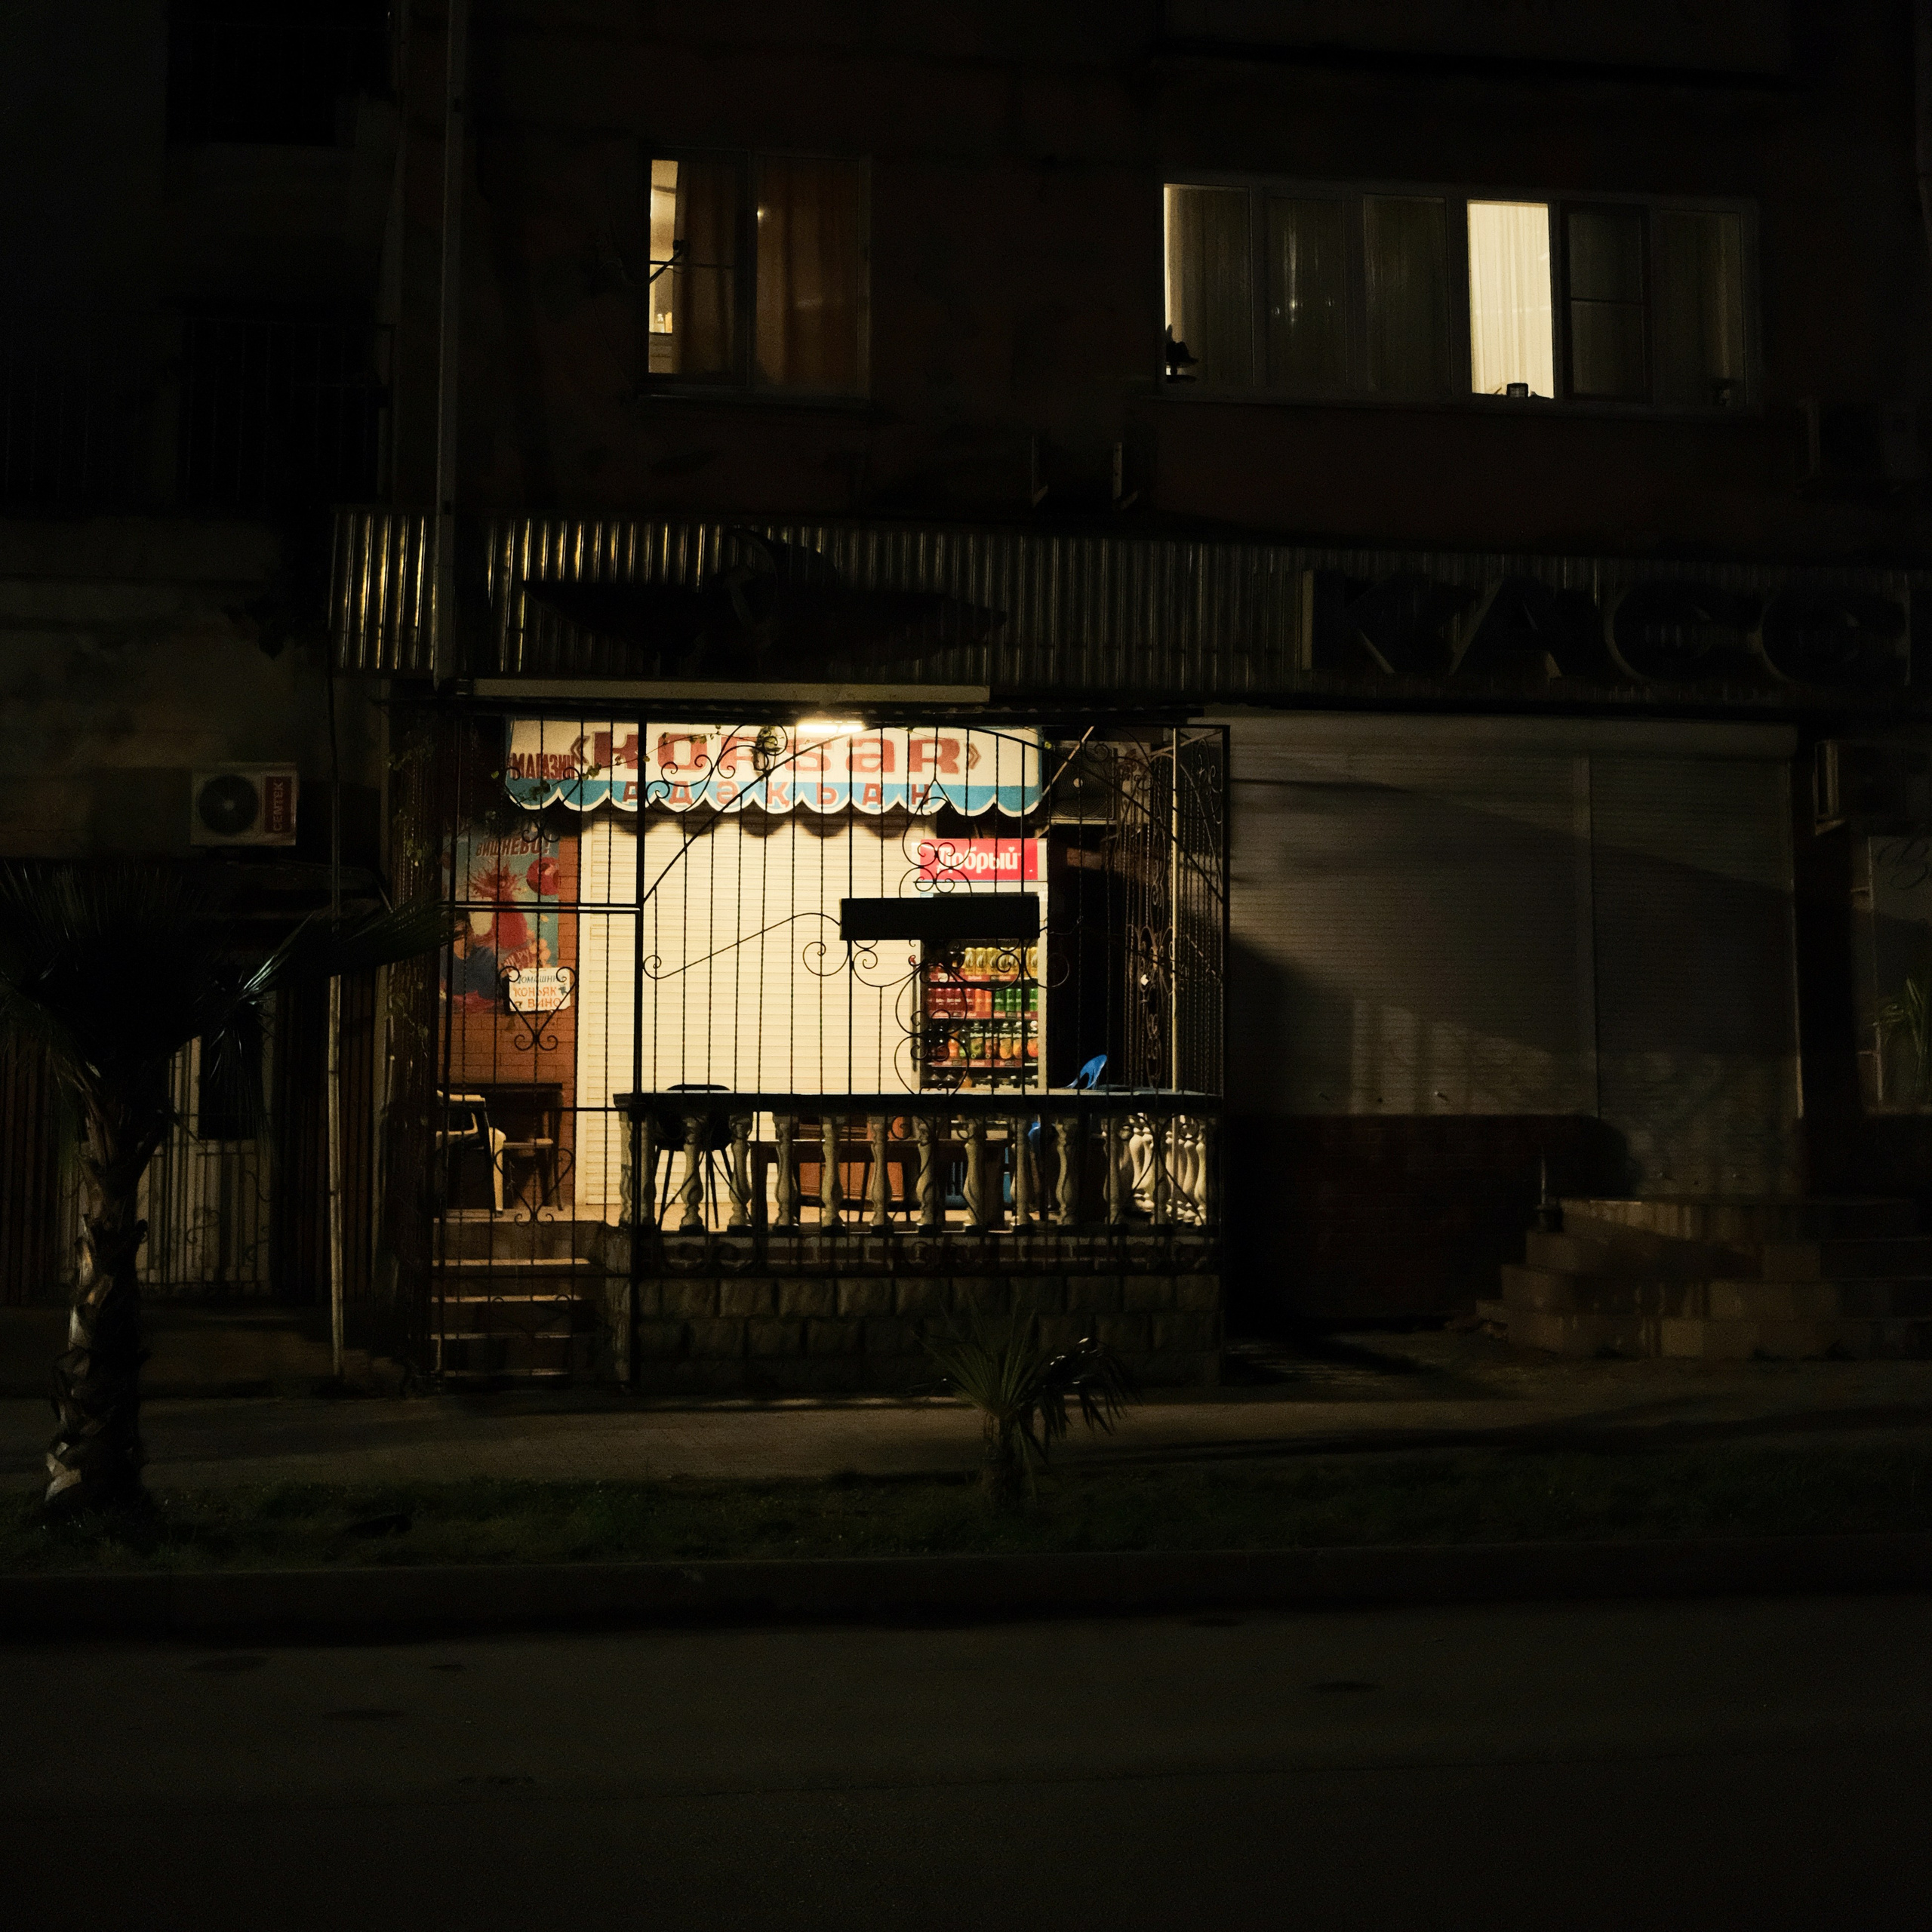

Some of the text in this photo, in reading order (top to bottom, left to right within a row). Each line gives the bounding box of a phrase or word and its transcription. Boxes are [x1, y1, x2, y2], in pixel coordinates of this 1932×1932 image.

[1300, 568, 1931, 689] КАСС
[510, 751, 575, 780] МАГАЗИН
[272, 778, 284, 832] CENTEK
[936, 846, 1019, 874] Добрый
[528, 997, 561, 1008] ВИНО
